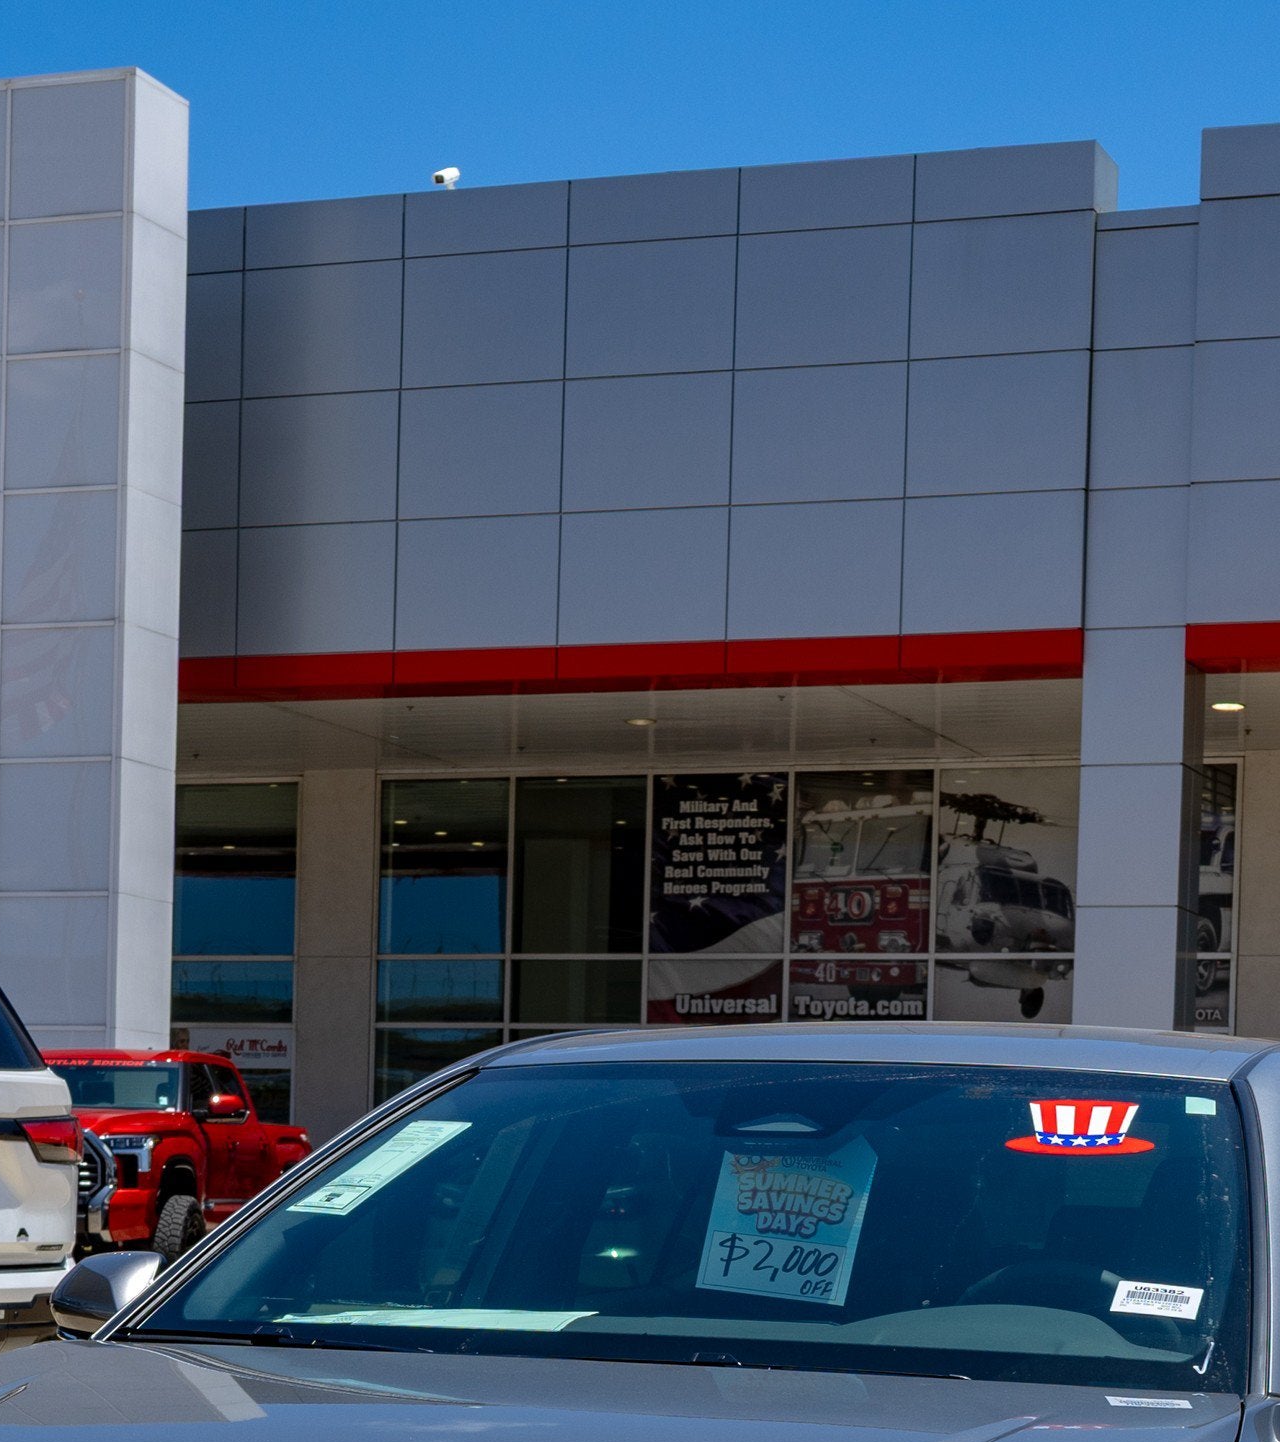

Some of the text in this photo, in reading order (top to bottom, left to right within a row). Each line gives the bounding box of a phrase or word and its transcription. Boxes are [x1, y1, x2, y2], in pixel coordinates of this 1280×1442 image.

[679, 799, 758, 815] Military And
[662, 815, 774, 831] First Responders,
[679, 832, 756, 845] Ask How To
[672, 848, 763, 861] Save With Our
[665, 865, 770, 879] Real Community
[663, 881, 770, 896] Heroes Program.
[825, 890, 872, 919] 40
[815, 962, 837, 982] 40
[675, 994, 924, 1020] Universal Toyota.com
[1195, 1008, 1222, 1020] OTA
[795, 1162, 828, 1172] TOYOTA
[738, 1172, 853, 1204] SUMMER
[737, 1191, 847, 1223] SAVINGS
[756, 1211, 818, 1238] DAYS
[718, 1232, 838, 1283] $2,000
[800, 1279, 834, 1296] OFF
